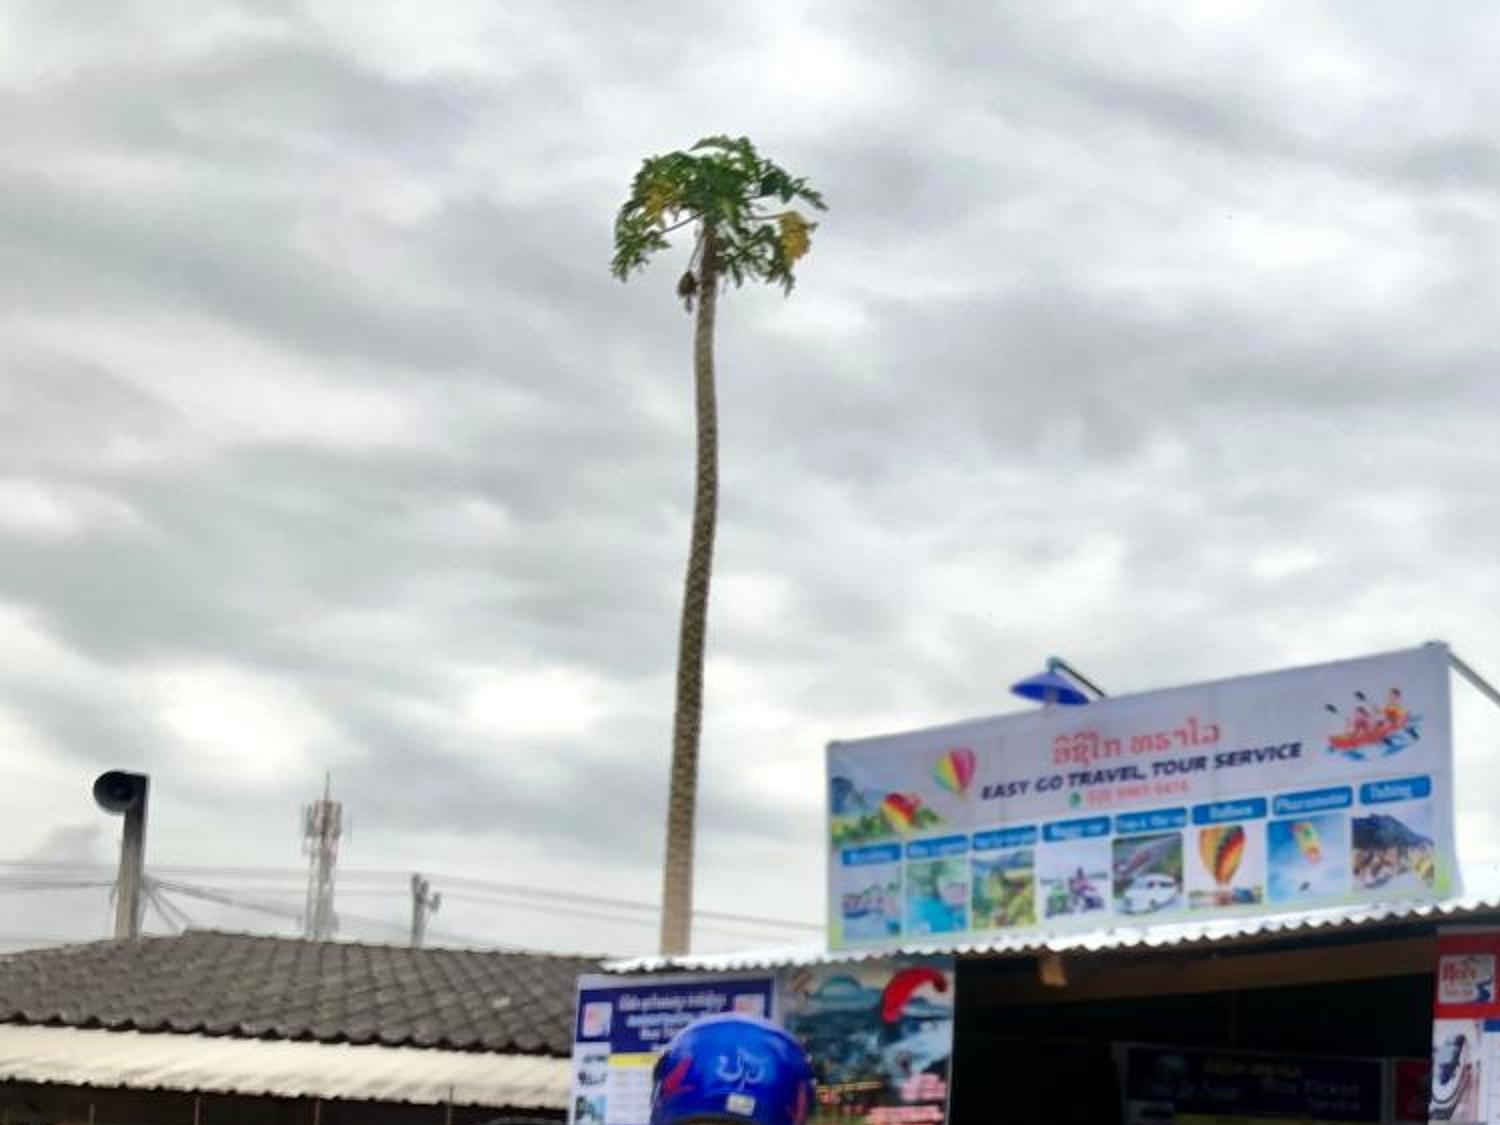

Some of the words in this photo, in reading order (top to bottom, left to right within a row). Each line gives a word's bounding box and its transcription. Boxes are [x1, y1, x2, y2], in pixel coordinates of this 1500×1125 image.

[983, 779, 1027, 800] EASY
[1036, 775, 1062, 792] GO
[1152, 753, 1206, 776] TOUR
[1214, 742, 1303, 769] SERVICE
